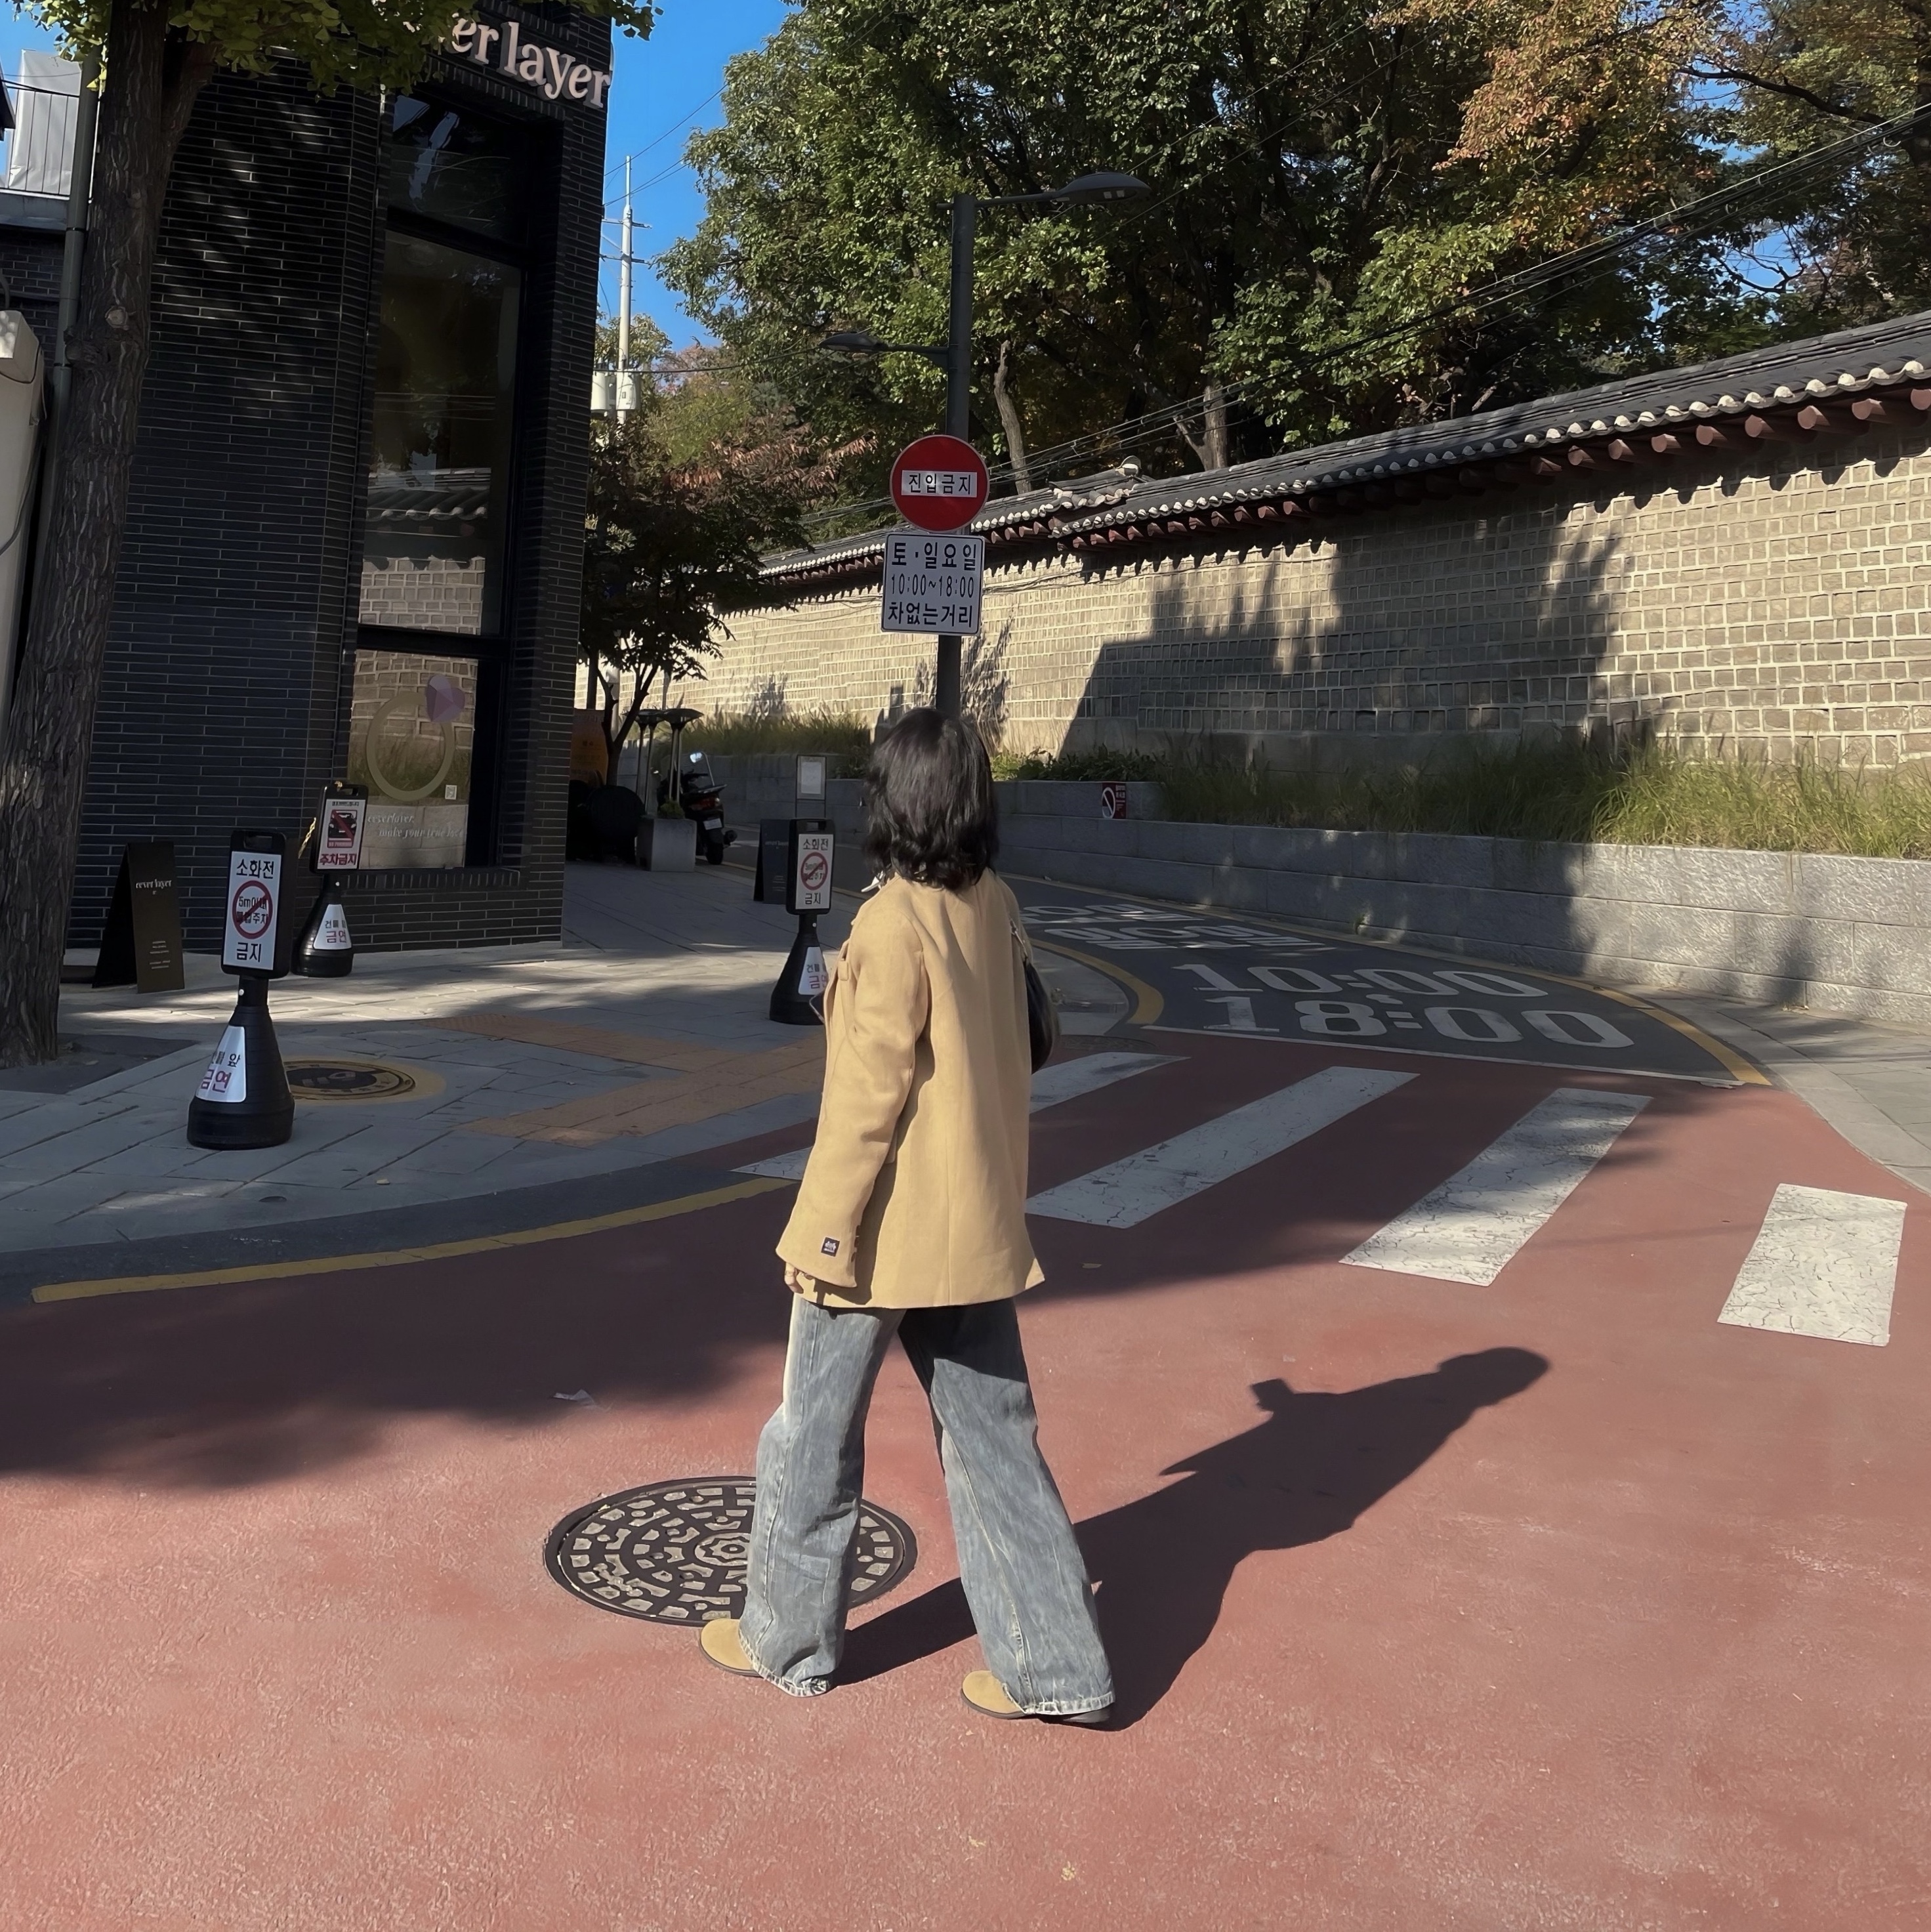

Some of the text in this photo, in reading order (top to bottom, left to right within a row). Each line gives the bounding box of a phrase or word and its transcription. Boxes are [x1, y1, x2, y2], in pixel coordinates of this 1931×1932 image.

[503, 21, 612, 108] layer
[908, 472, 971, 495] 진입금지
[891, 573, 974, 598] 10:00~18:00
[888, 601, 972, 628] 차없는거리
[236, 858, 274, 879] 소화전
[319, 853, 357, 866] 주차금지
[804, 892, 821, 905] 금지
[1020, 904, 1205, 923] 요일
[325, 930, 347, 944] 금연
[236, 942, 262, 963] 금지
[1171, 963, 1548, 998] 10:00
[1203, 996, 1635, 1048] 18:00
[227, 1053, 241, 1068] 앞
[200, 1069, 232, 1093] 금연
